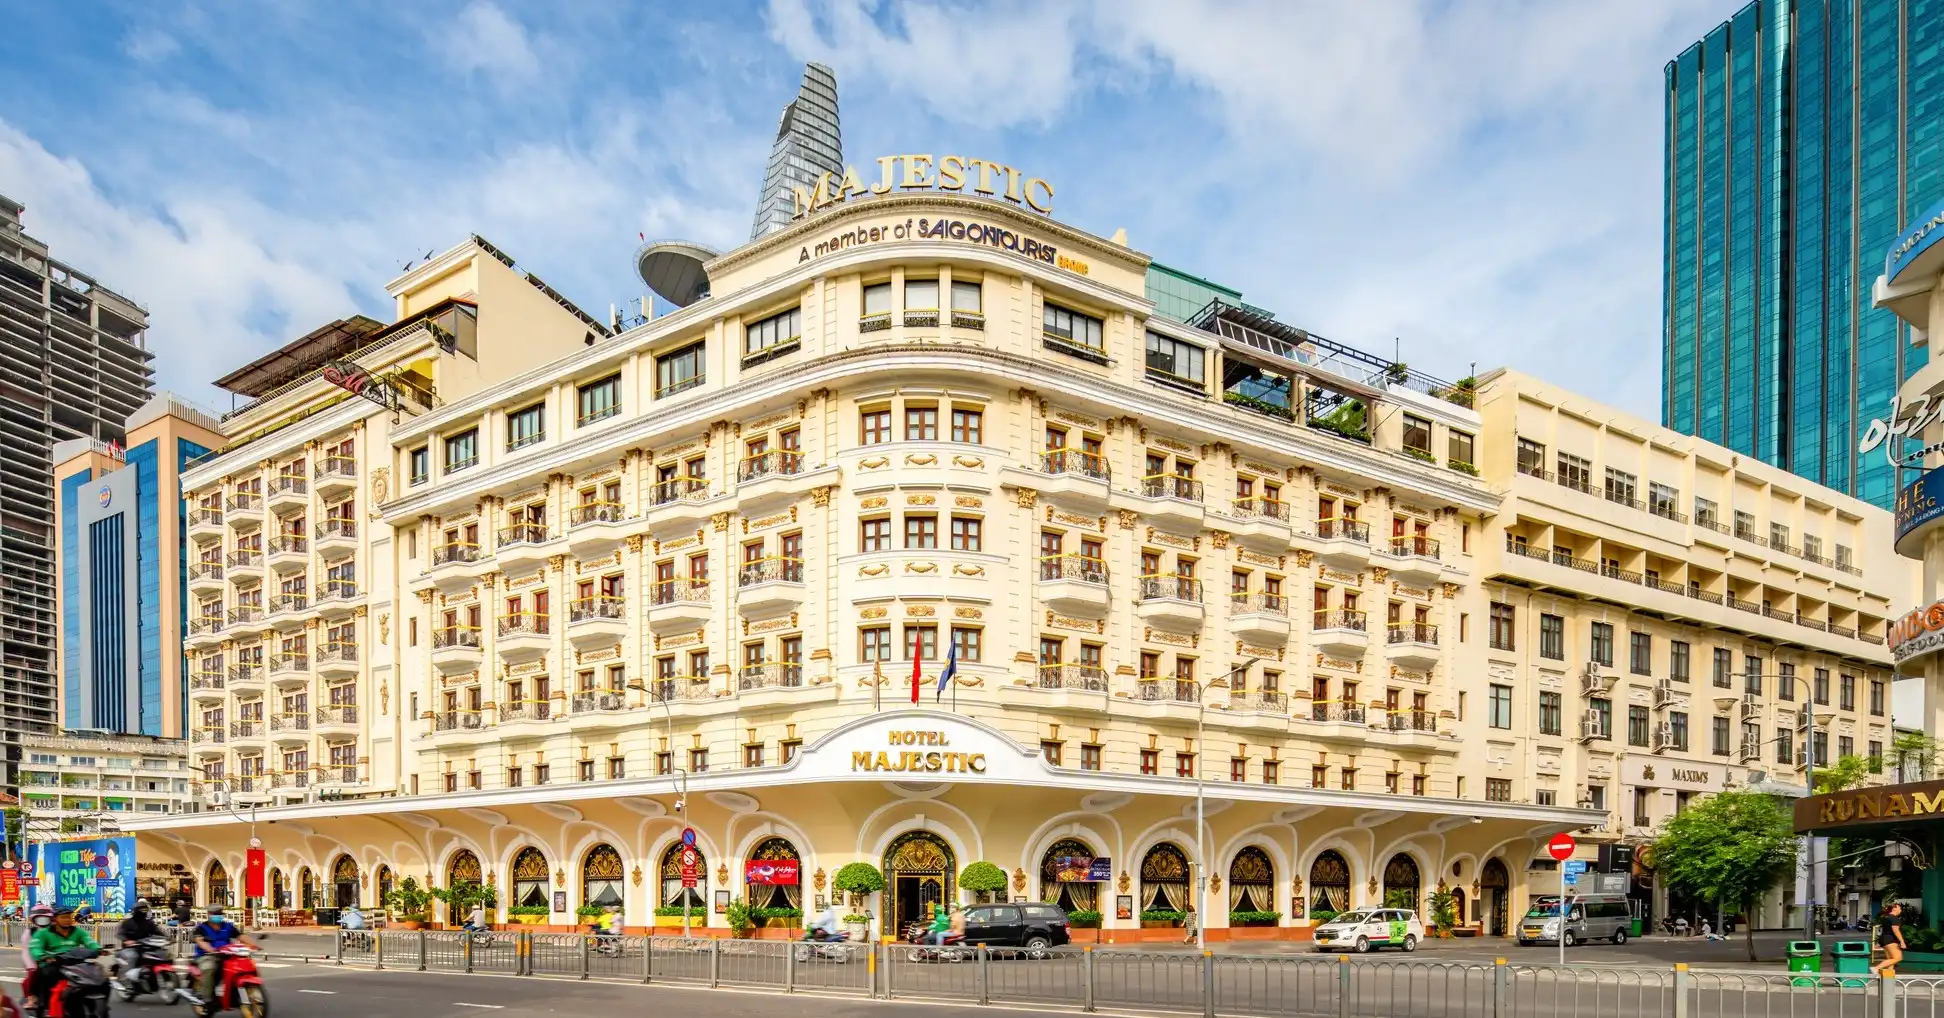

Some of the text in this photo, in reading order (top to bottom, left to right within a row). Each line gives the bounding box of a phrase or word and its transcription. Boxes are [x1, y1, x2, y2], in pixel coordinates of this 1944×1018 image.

[792, 154, 1055, 220] MAJESTIC
[799, 246, 810, 264] A
[815, 225, 888, 258] member
[894, 218, 913, 239] of
[917, 218, 1057, 265] SAIGONTOURIST
[1909, 442, 1944, 461] KORE
[889, 730, 950, 746] HOTEL
[851, 751, 987, 774] MAJESTIC
[1820, 790, 1944, 823] RUNAM
[61, 868, 97, 894] SOJU
